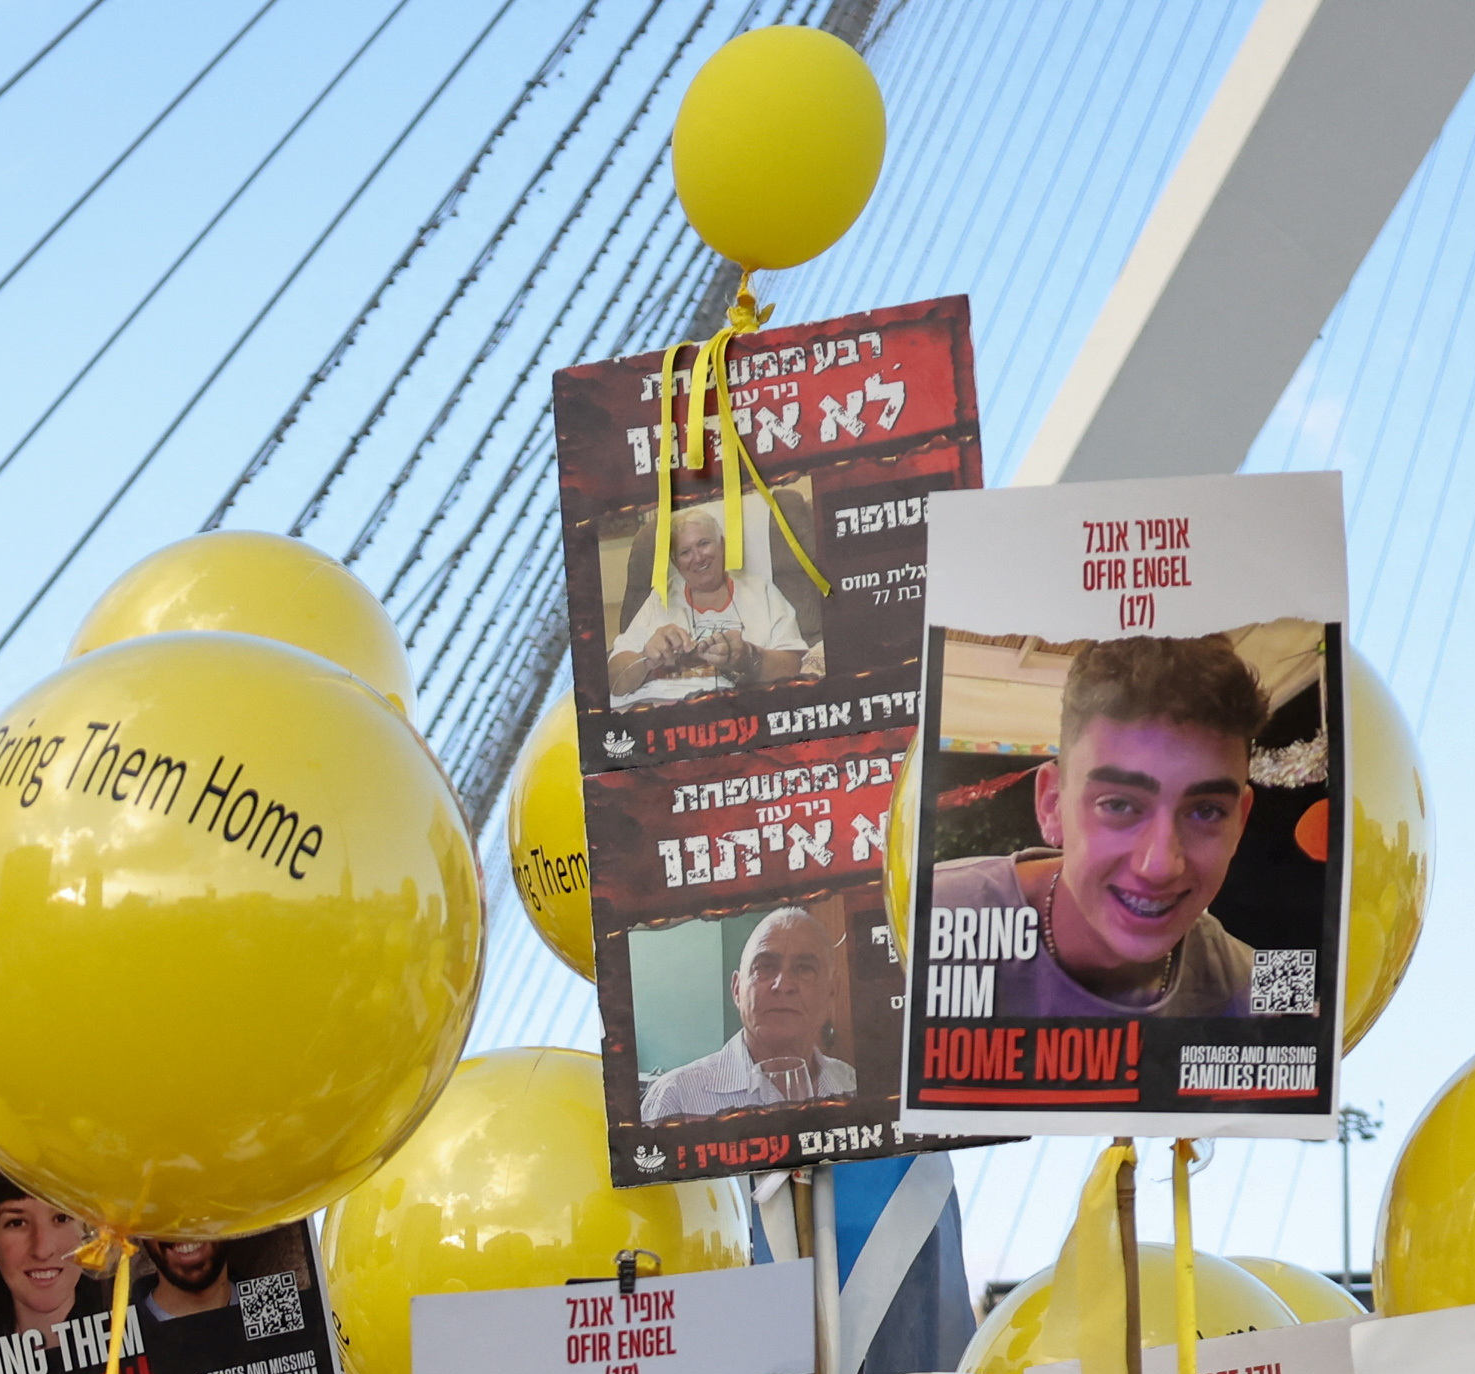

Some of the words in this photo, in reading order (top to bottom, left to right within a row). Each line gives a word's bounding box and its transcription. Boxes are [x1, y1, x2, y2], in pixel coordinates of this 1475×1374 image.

[812, 332, 882, 375] רבע
[819, 363, 906, 443] לא
[1083, 520, 1130, 554] אנגל
[1135, 518, 1191, 552] אופיר
[841, 572, 880, 592] מוזס
[1083, 559, 1127, 592] OFIR
[1133, 555, 1192, 590] ENGEL
[872, 590, 890, 606] 77
[896, 584, 921, 602] בת
[1119, 593, 1155, 630] (17)
[64, 722, 189, 815] Them
[189, 754, 324, 880] Home
[671, 760, 840, 814] ממשפחת
[755, 805, 792, 825] עוז
[798, 797, 831, 817] ניר
[658, 818, 834, 888] איתנו
[929, 906, 1039, 961] BRING
[927, 965, 995, 1018] HIM
[923, 1028, 1026, 1080] HOME
[1033, 1021, 1141, 1082] NOW!
[695, 1133, 790, 1169] עכשיו
[798, 1123, 883, 1155] אותם
